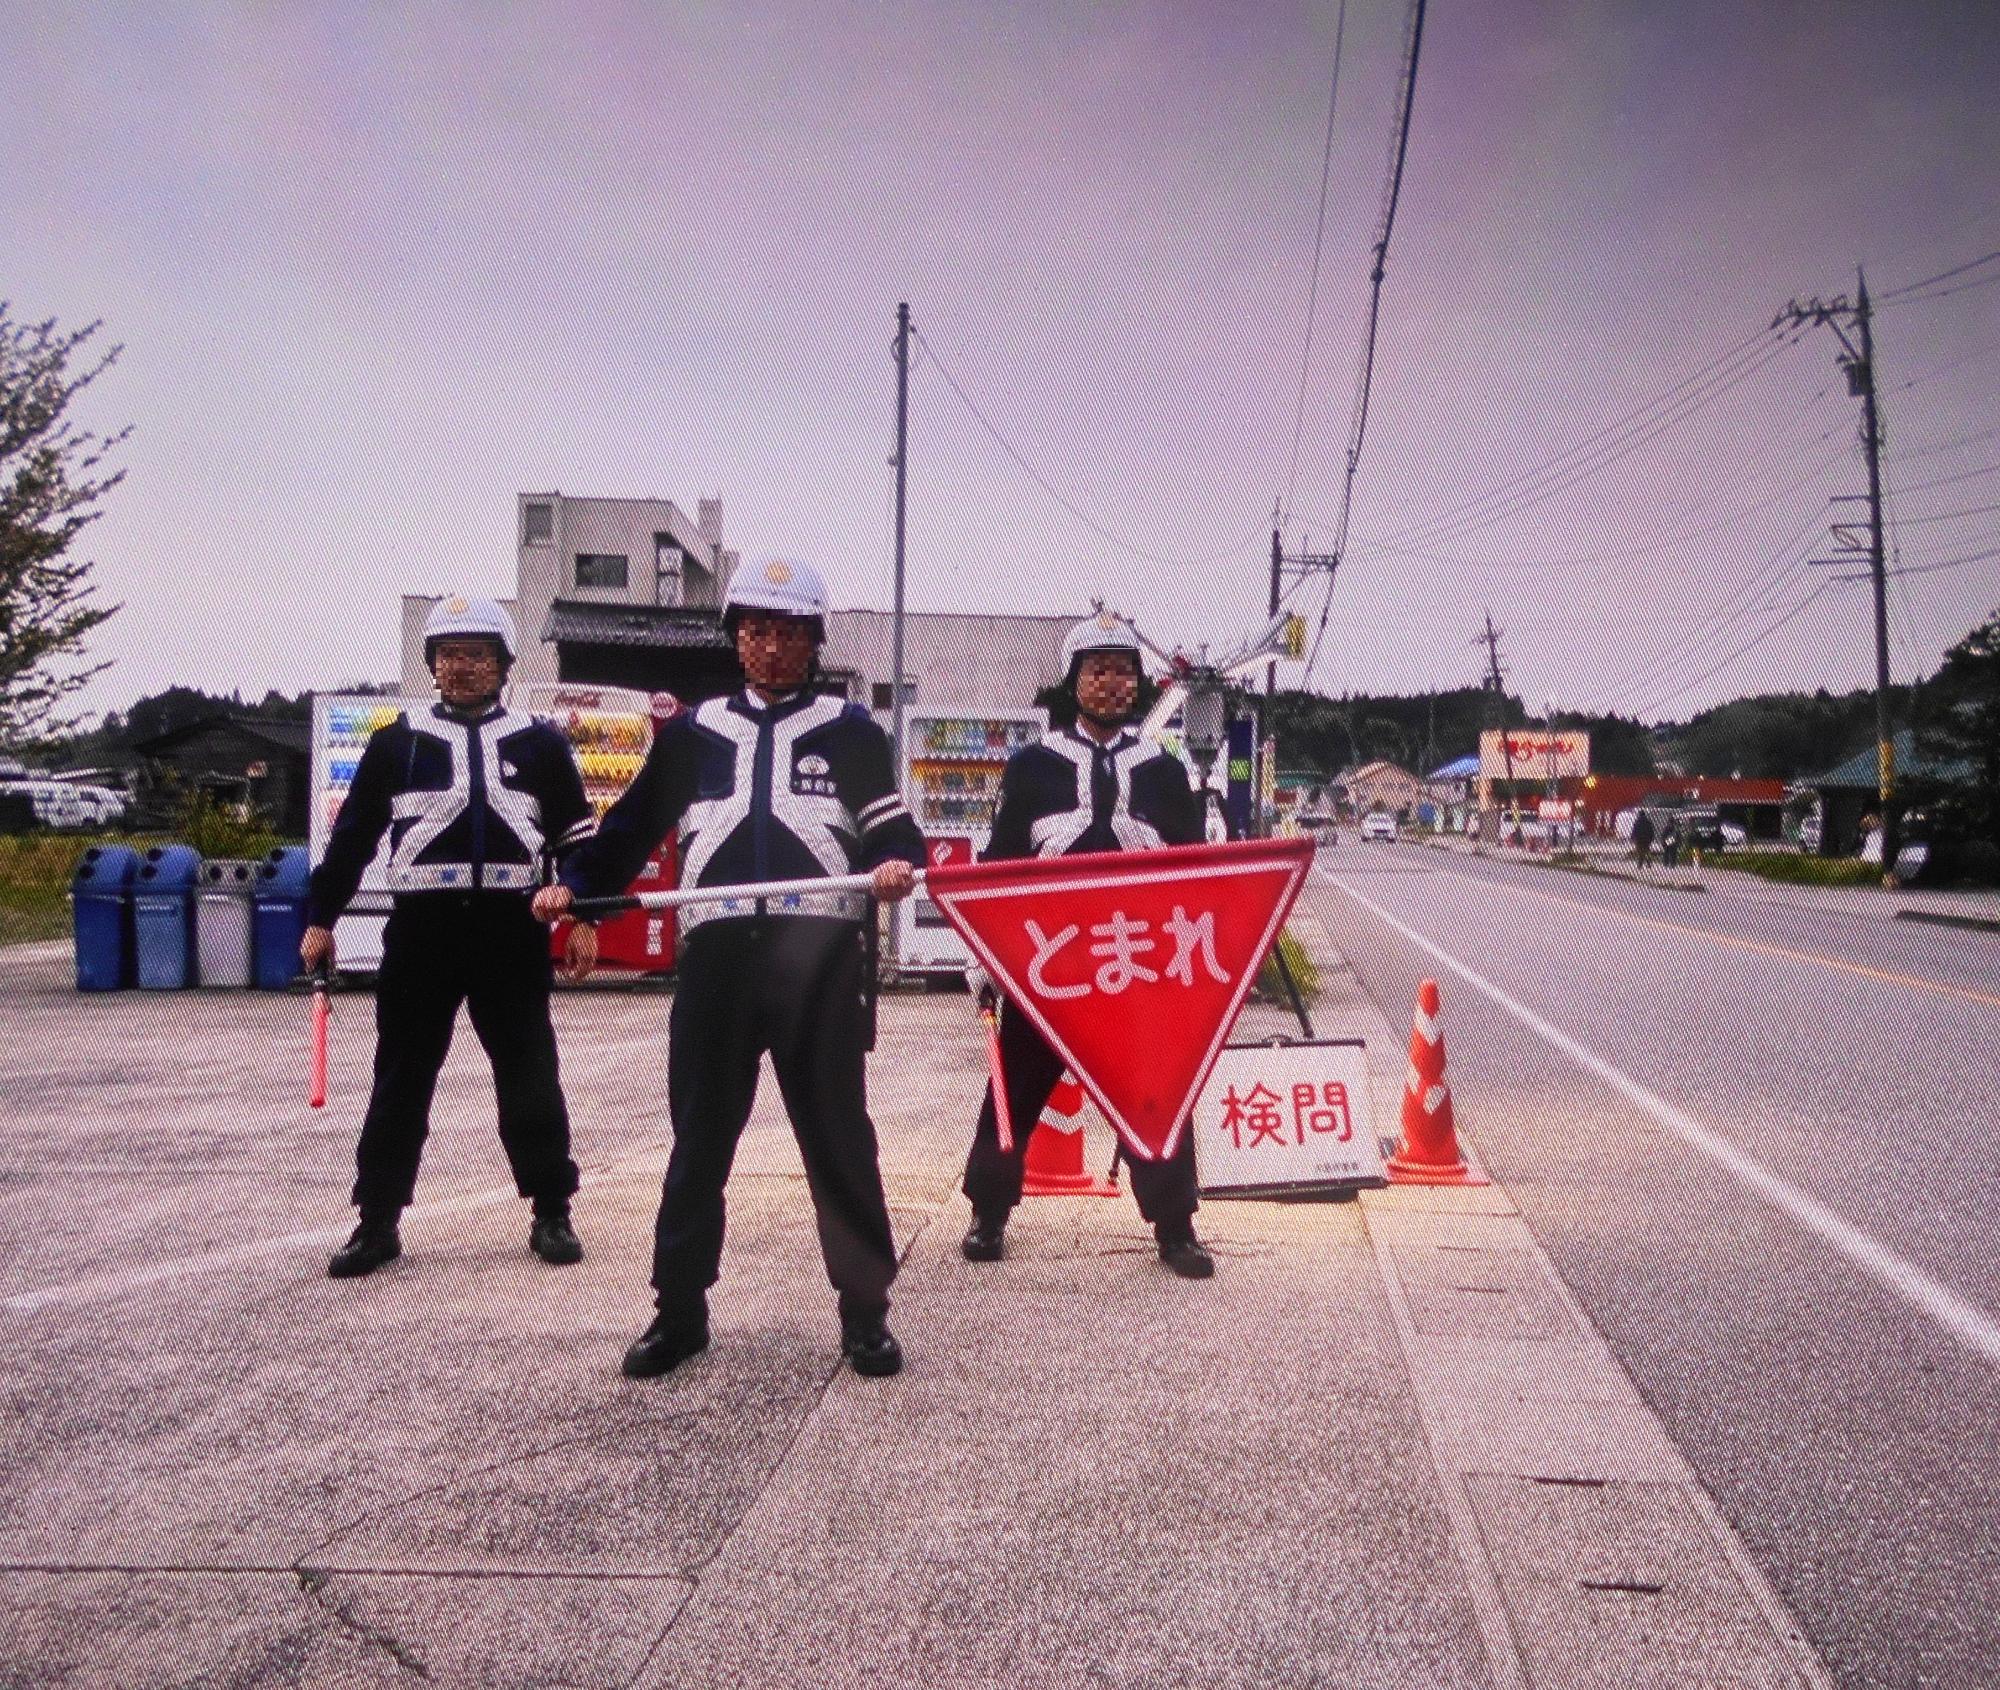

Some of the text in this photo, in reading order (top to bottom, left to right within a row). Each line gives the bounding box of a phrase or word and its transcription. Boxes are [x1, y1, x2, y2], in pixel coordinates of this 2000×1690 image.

[1024, 906, 1232, 1000] とまれ
[1222, 1081, 1353, 1150] 検問
